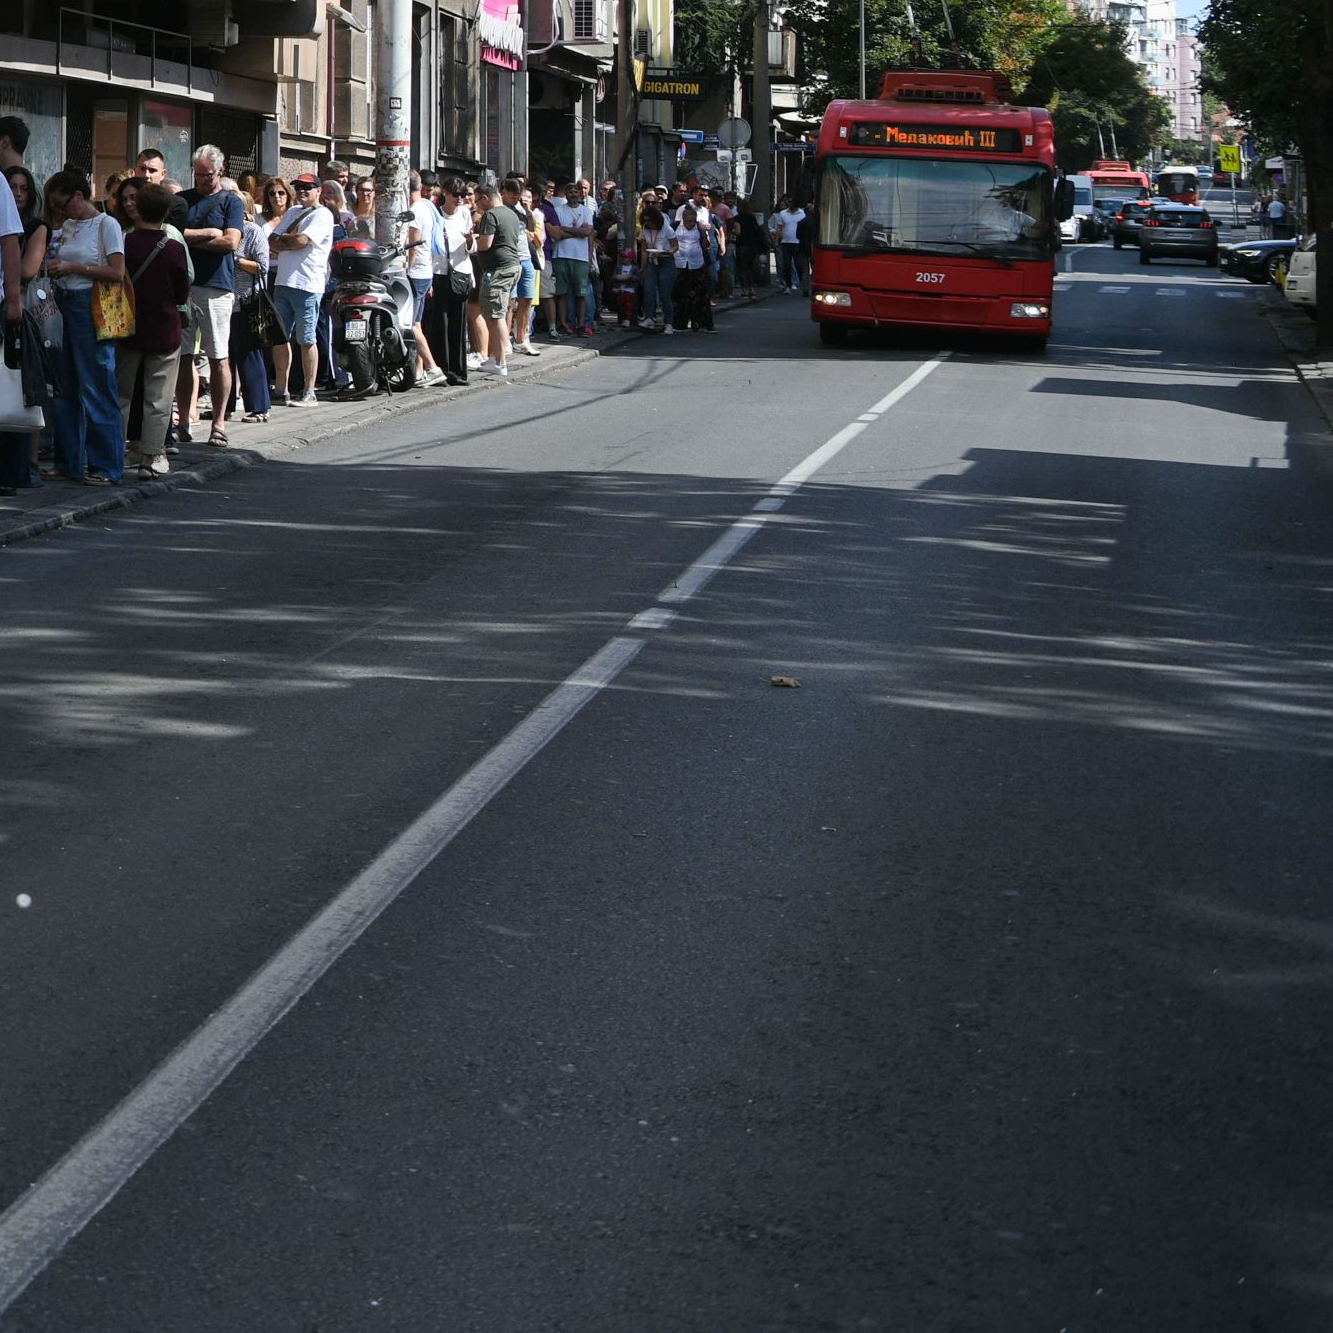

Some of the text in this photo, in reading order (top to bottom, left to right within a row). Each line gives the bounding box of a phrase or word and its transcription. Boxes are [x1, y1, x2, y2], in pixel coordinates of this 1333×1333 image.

[644, 81, 699, 95] GIGATRON
[885, 126, 975, 148] Медаковић
[916, 272, 945, 284] 2057
